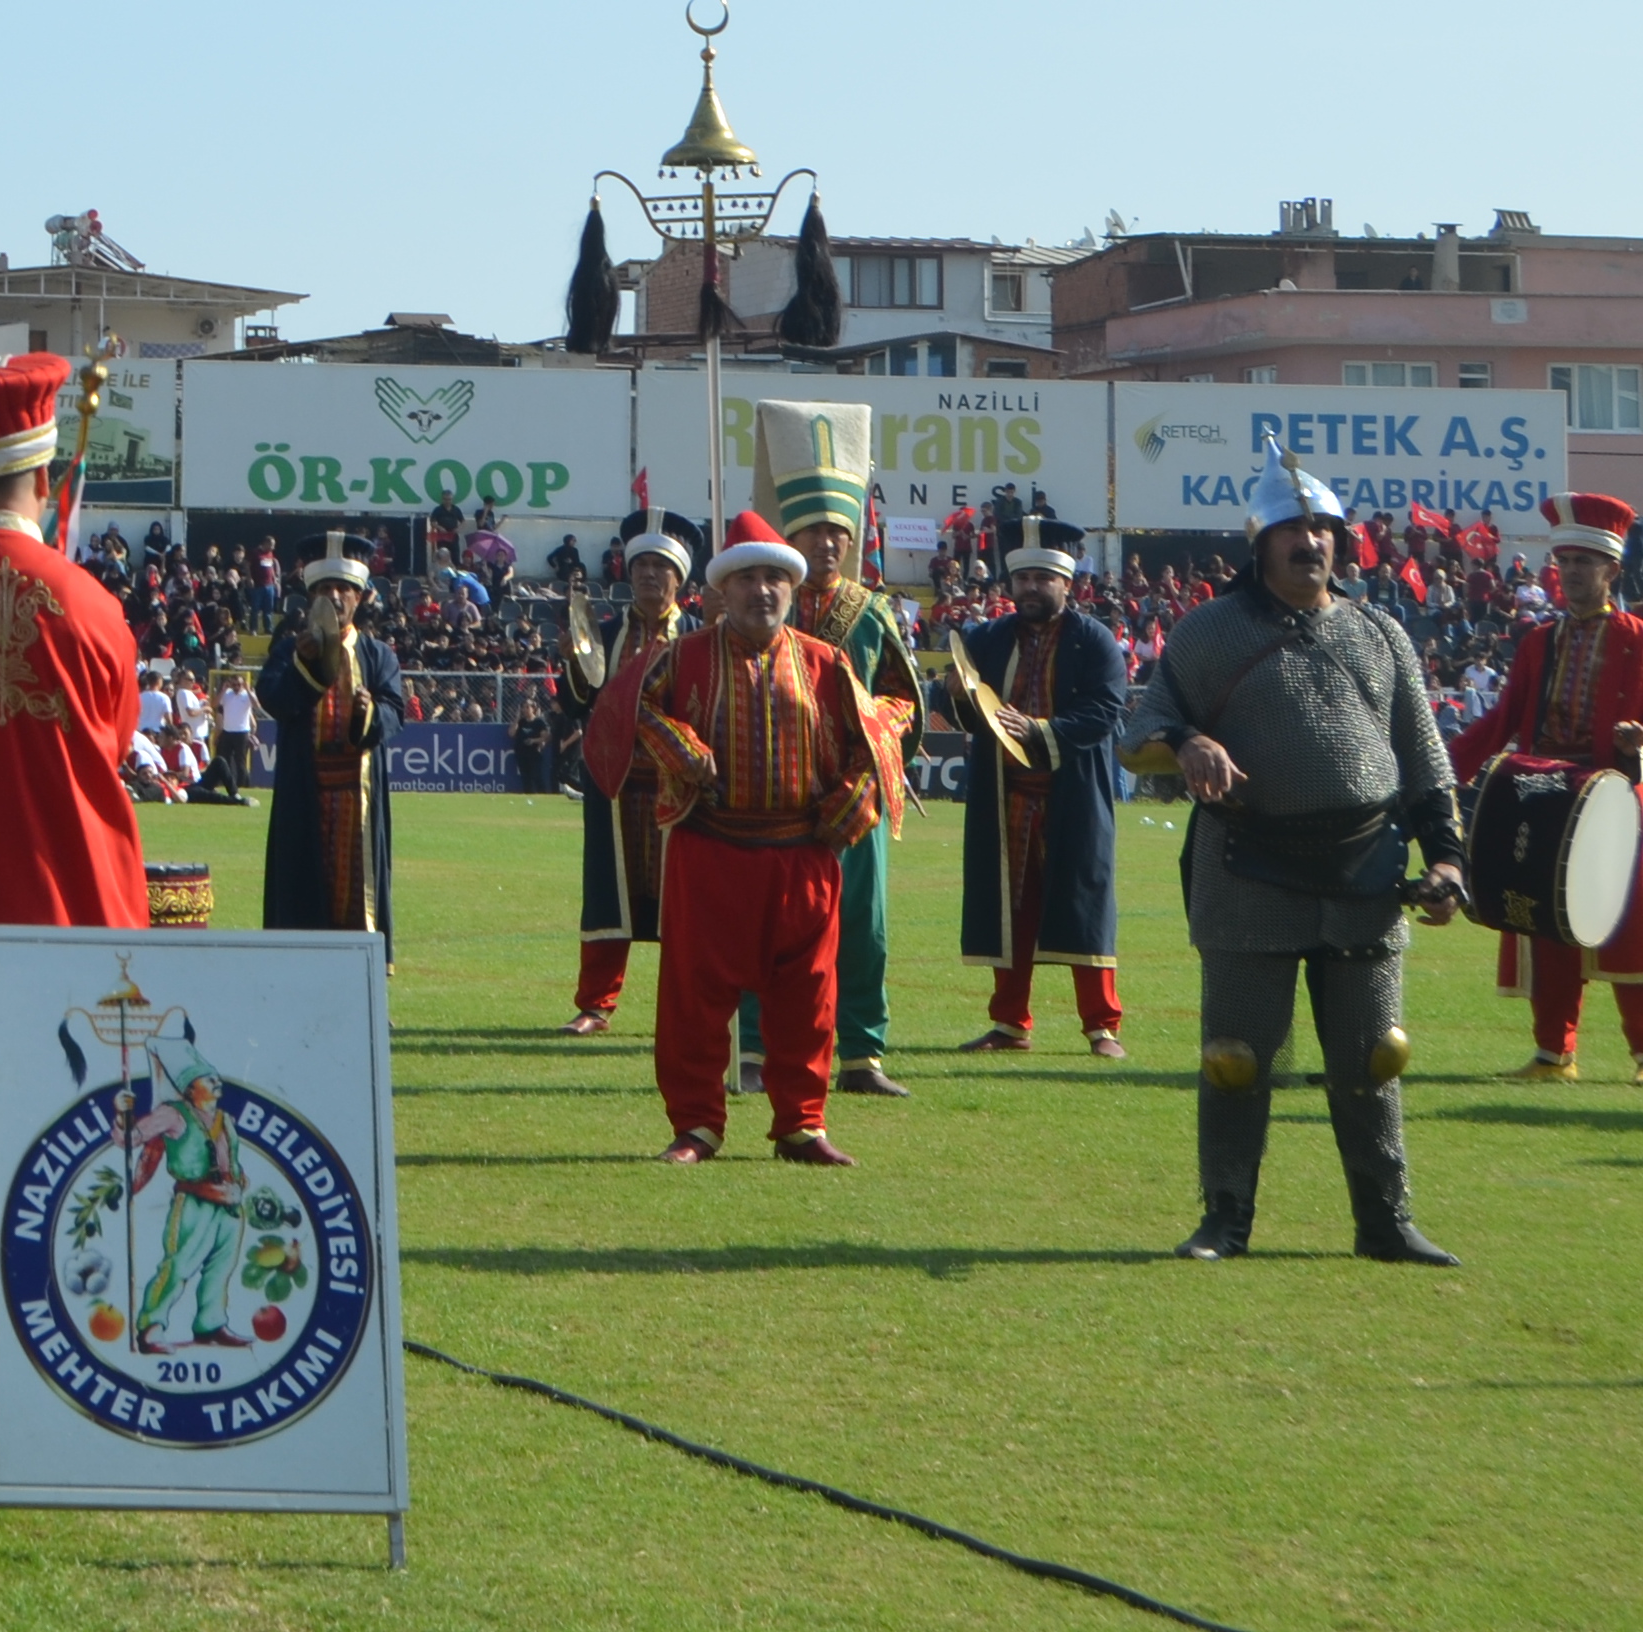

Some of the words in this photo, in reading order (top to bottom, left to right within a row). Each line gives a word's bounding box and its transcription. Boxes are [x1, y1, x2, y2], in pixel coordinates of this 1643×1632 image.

[123, 369, 151, 388] İLE
[938, 390, 1040, 413] NAZİLLİ
[709, 396, 1042, 475] Rrans
[1161, 425, 1221, 439] RETECH
[1439, 417, 1546, 471] A.Ş.
[247, 442, 570, 508] ÖR-KOOP
[1330, 470, 1548, 513] FABRİKASI
[389, 779, 446, 792] matbaa
[459, 779, 505, 793] tabela
[15, 1099, 112, 1242] NAZİLLİ
[236, 1100, 366, 1297] BELEDİYESİ
[20, 1299, 166, 1432] MEHTER
[202, 1328, 343, 1433] TAKIMI
[156, 1361, 222, 1384] 2010
